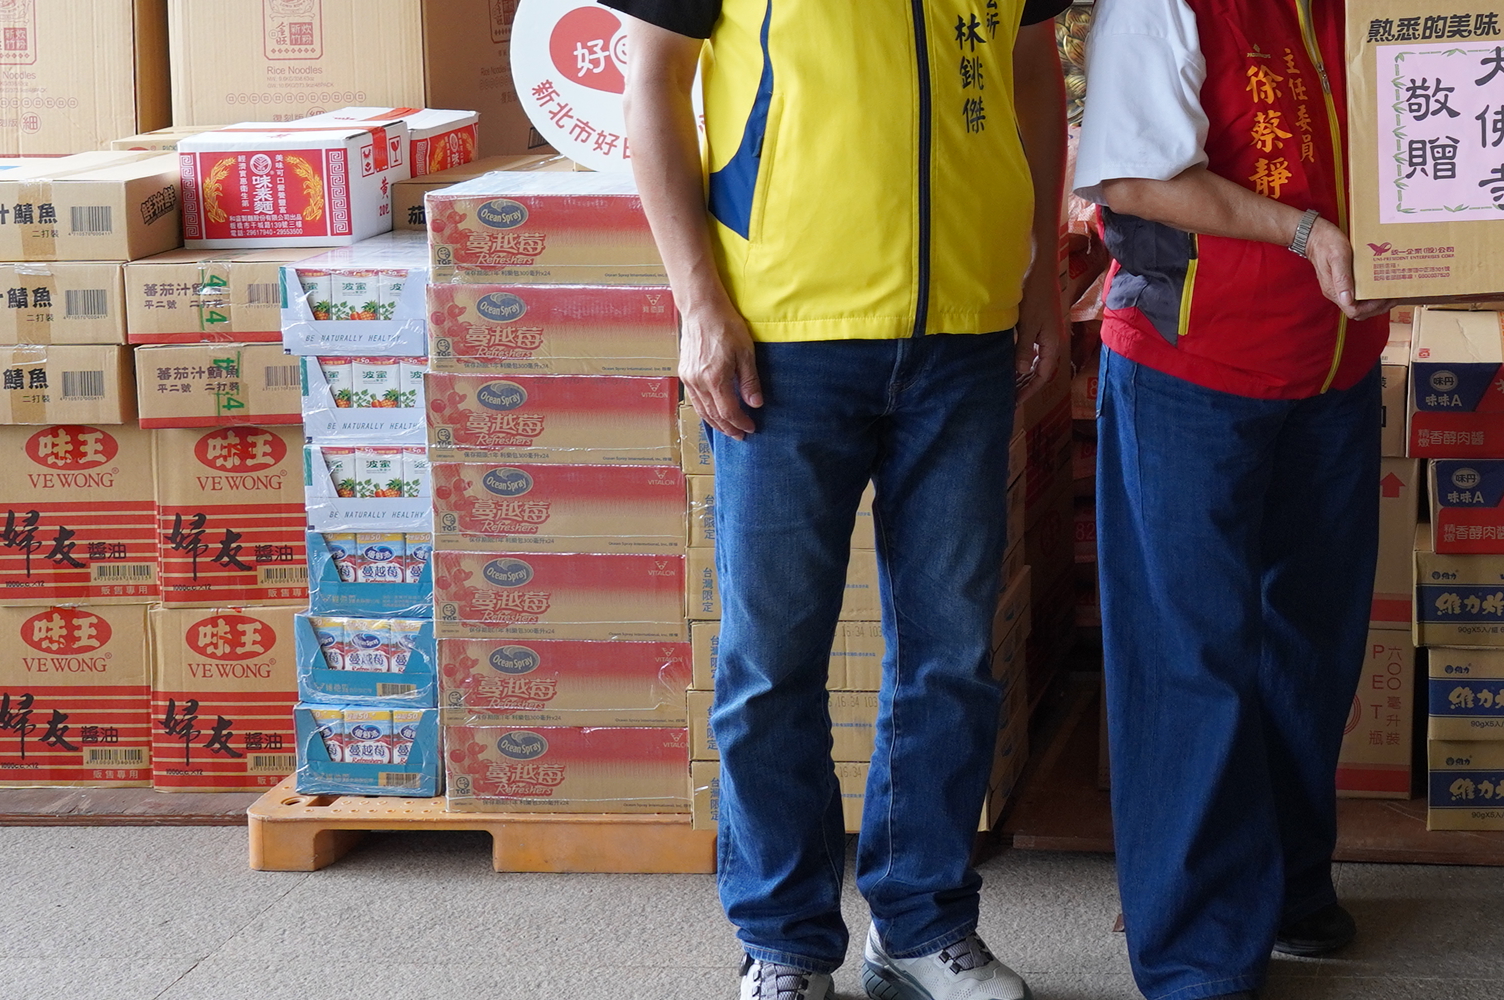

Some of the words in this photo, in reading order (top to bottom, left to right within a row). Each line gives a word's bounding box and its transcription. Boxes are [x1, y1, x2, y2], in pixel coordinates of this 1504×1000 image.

[1367, 12, 1501, 43] 熟悉的美味
[574, 39, 610, 77] 好
[3, 71, 37, 80] Noodles
[267, 66, 286, 75] Rice
[288, 66, 323, 75] Noodles
[1283, 48, 1315, 163] 主任委員
[23, 115, 39, 131] 細
[1405, 77, 1461, 180] 敬贈
[481, 208, 502, 223] Ocean
[501, 210, 521, 225] Spray
[32, 229, 59, 238] 二打裝
[467, 232, 545, 255] 蔓越莓
[477, 253, 533, 265] Refreshers
[321, 334, 363, 342] NATURALLY
[3, 369, 49, 390] 鯖魚
[23, 394, 50, 403] 二打裝
[480, 389, 501, 405] Ocean
[500, 390, 521, 406] Spray
[1425, 395, 1462, 407] 味味A
[466, 412, 545, 436] 蔓越莓
[38, 428, 107, 466] 味王
[476, 433, 532, 446] Refreshers
[207, 428, 278, 469] 味王
[1448, 492, 1485, 504] 味味A
[344, 511, 386, 519] NATURALLY
[88, 542, 126, 560] 醬油
[254, 544, 293, 562] 醬油
[33, 610, 102, 651] 味王
[198, 615, 266, 656] 味王
[500, 739, 522, 753] Ocean
[521, 740, 541, 755] Spray
[486, 763, 565, 785] 蔓越莓
[497, 783, 553, 796] Refreshers
